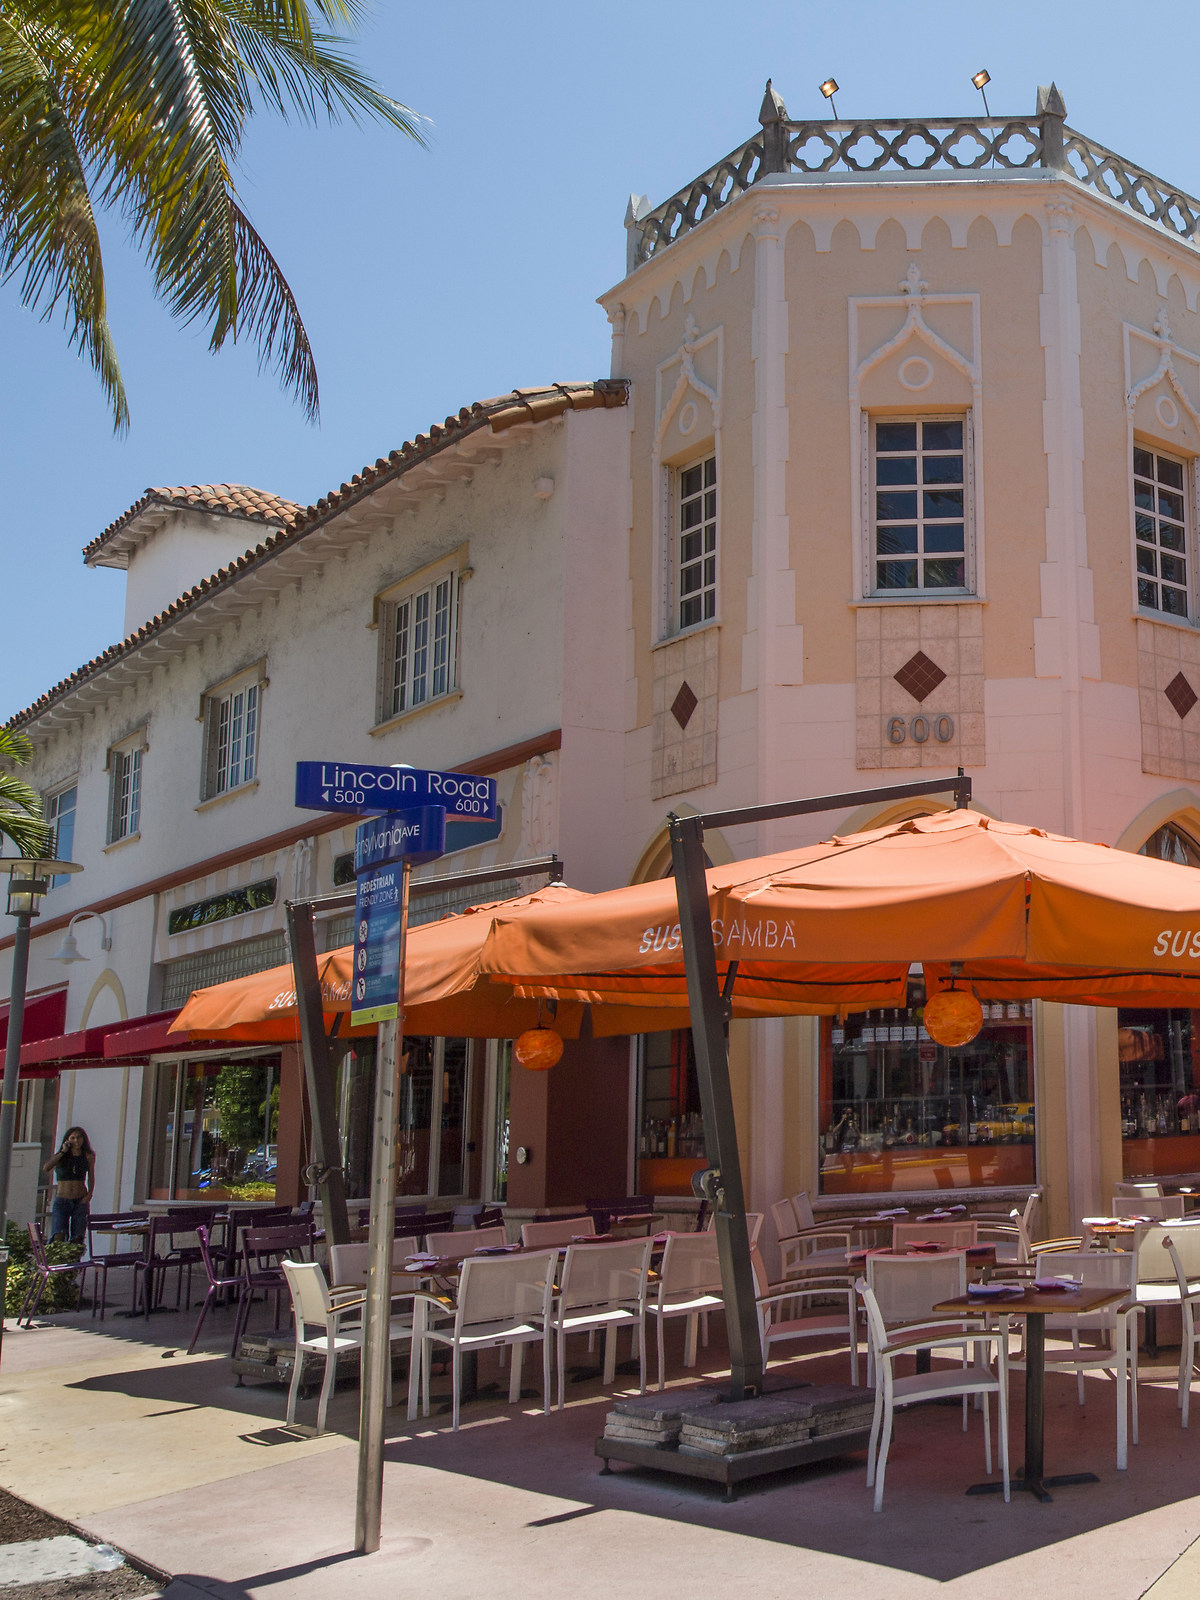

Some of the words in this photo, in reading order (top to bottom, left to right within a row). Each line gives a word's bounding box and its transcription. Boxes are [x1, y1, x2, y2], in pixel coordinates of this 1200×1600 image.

[887, 714, 954, 744] 600
[321, 765, 417, 792] Lincoln
[428, 772, 490, 800] Road
[334, 790, 365, 804] 500
[455, 799, 480, 813] 600
[402, 824, 420, 837] AVE
[360, 873, 395, 895] PEDESTRIAN
[379, 888, 394, 903] ZONE
[638, 918, 797, 954] SUSSAMBA
